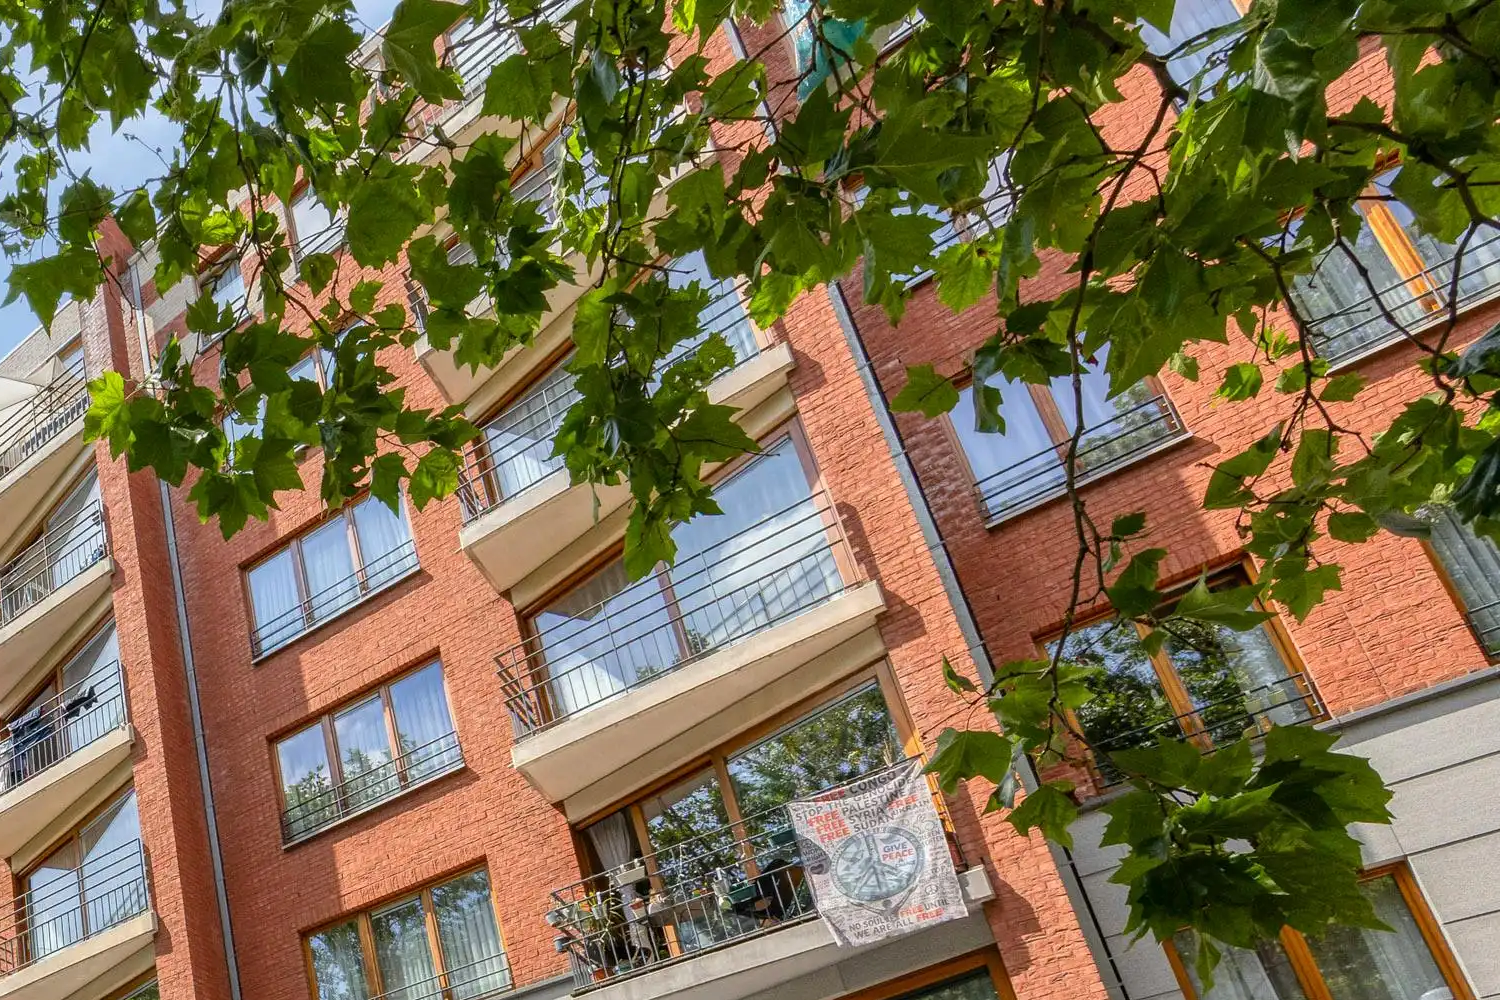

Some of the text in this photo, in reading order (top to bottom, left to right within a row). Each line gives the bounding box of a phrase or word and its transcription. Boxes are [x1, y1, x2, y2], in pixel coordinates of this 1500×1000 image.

[849, 770, 897, 794] CONGO
[796, 776, 913, 822] STOP THE GENOCIDE
[806, 788, 905, 826] FREE PALESTINE
[815, 794, 918, 835] FREE SYRIA FREE
[820, 828, 850, 843] FREE
[854, 815, 894, 833] SUDAN
[882, 848, 914, 861] PEACE
[883, 842, 908, 853] GIVE
[849, 923, 861, 932] NO
[862, 917, 883, 928] SOUL
[854, 929, 870, 939] WE
[873, 924, 892, 935] ARE
[896, 919, 914, 928] ALL
